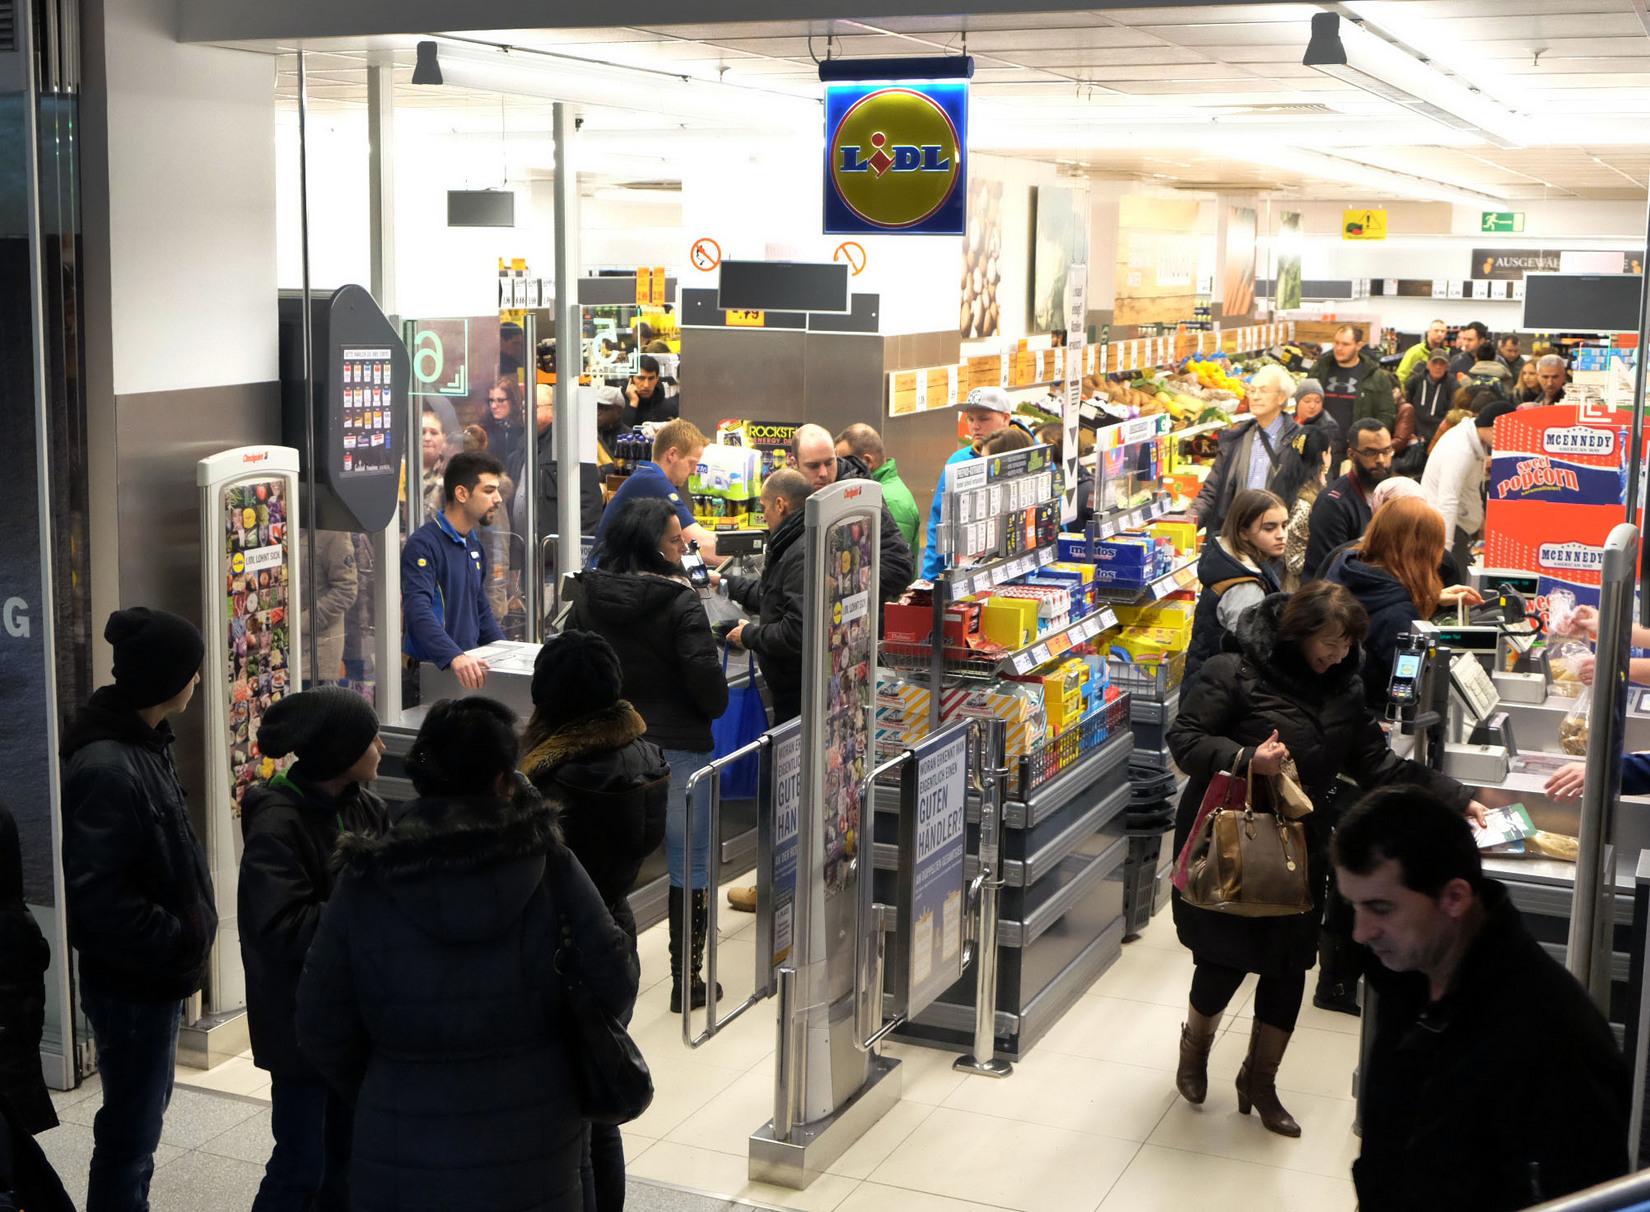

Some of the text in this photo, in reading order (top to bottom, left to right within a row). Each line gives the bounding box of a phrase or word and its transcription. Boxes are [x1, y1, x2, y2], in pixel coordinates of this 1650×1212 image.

[840, 131, 950, 179] LIDL
[750, 425, 796, 439] ROCKST
[1546, 433, 1612, 448] MCENNEDY
[778, 774, 801, 807] GUTE
[919, 784, 948, 825] GUTEN
[777, 804, 797, 841] HÄN
[918, 806, 963, 859] HÄNDLER?
